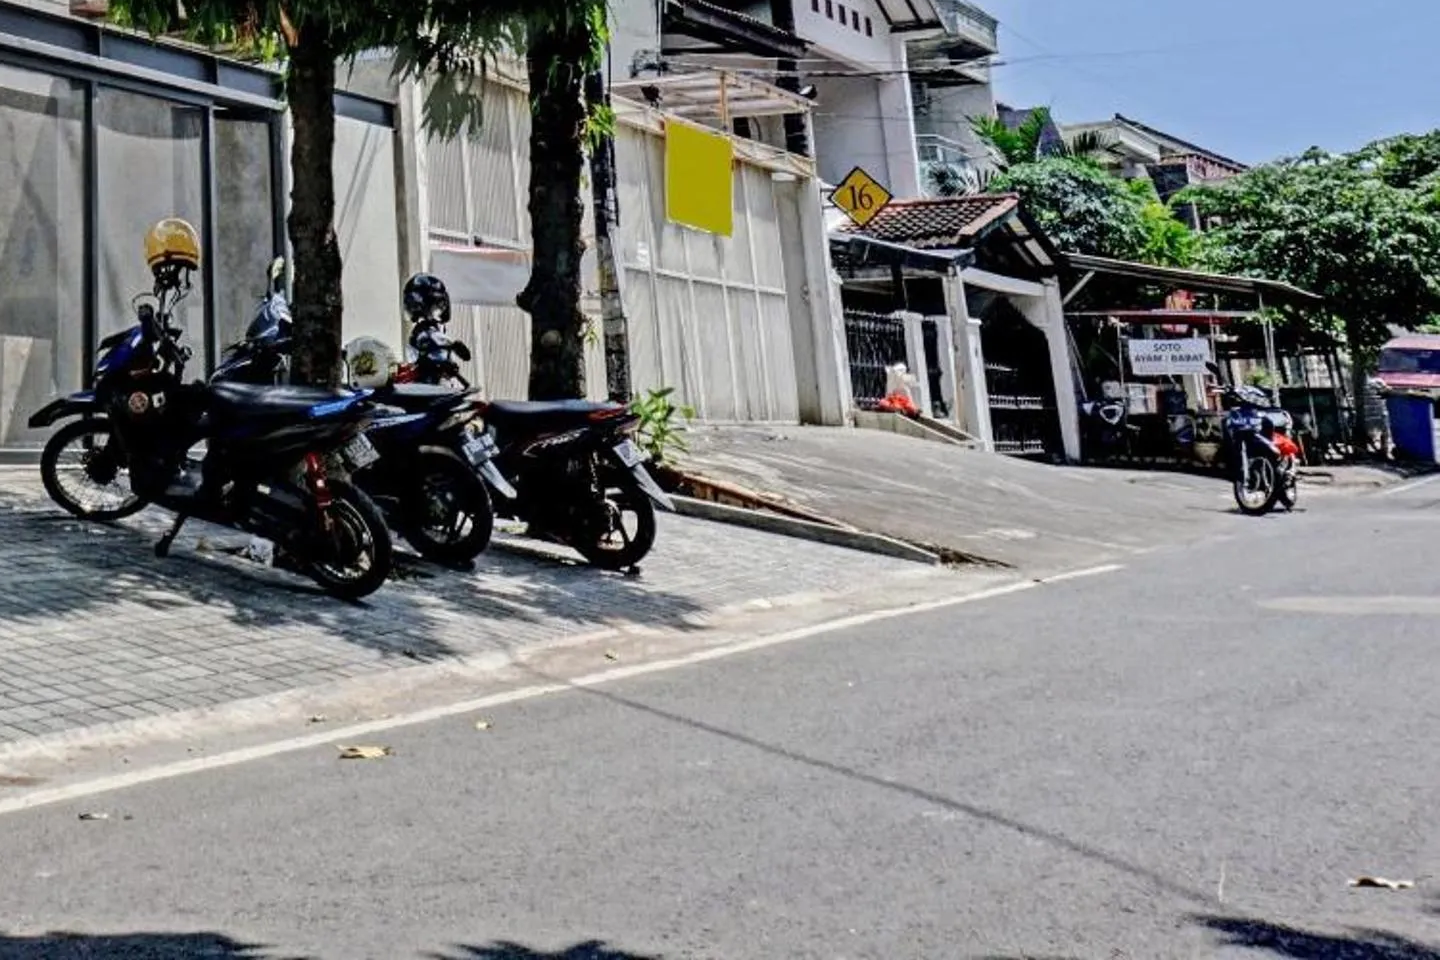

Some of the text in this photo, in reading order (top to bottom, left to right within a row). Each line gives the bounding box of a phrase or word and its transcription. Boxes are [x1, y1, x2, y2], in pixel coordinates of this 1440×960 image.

[848, 183, 874, 211] 16
[1153, 343, 1182, 352] SOTO
[1134, 354, 1163, 362] AYAM
